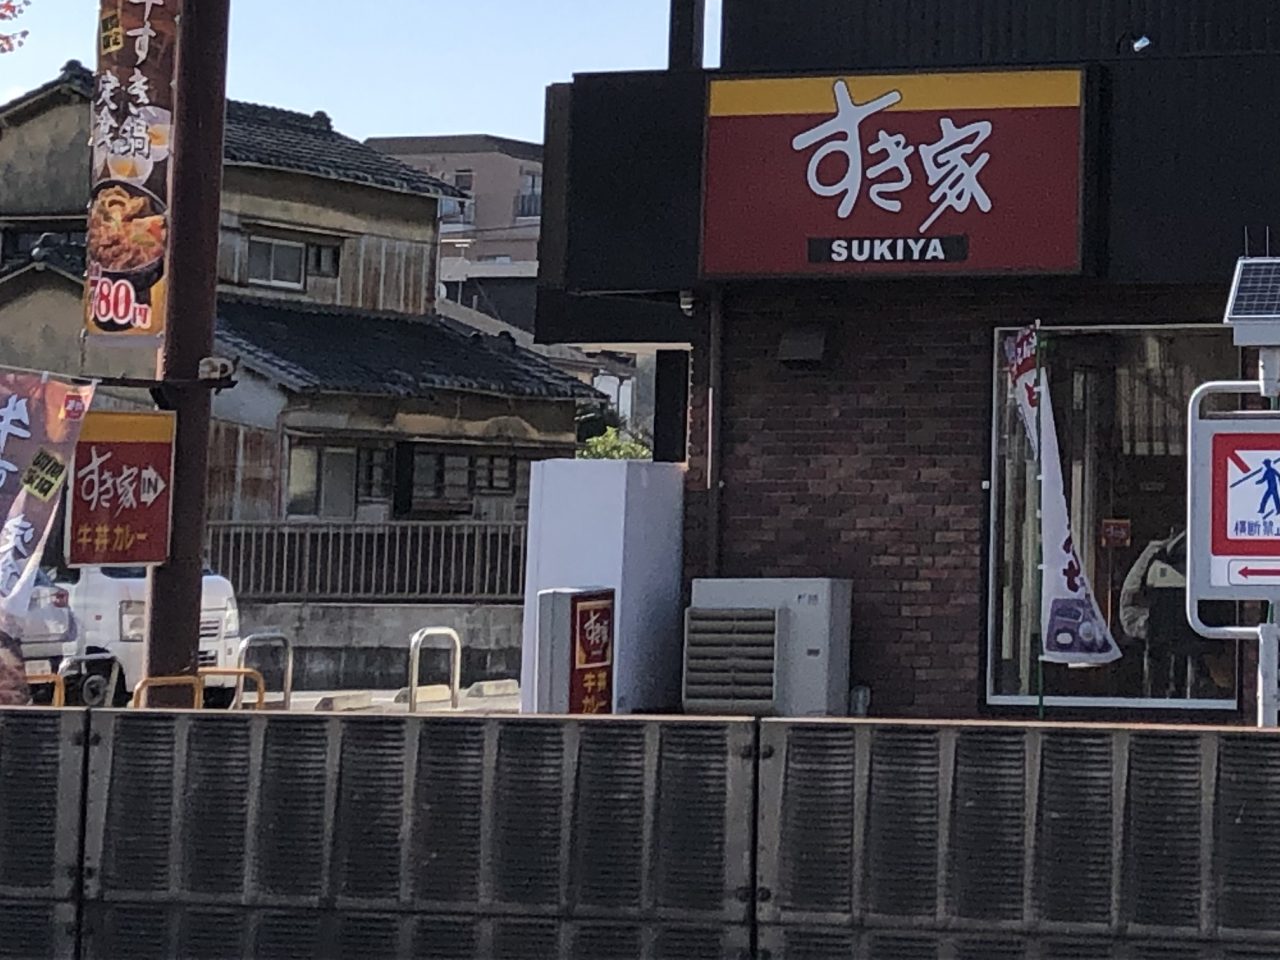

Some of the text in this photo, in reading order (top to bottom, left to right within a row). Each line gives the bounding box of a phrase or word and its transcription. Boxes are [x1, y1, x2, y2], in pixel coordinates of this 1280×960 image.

[791, 78, 993, 234] すき家
[830, 238, 946, 262] SUKIYA
[77, 445, 159, 519] すき家 IN
